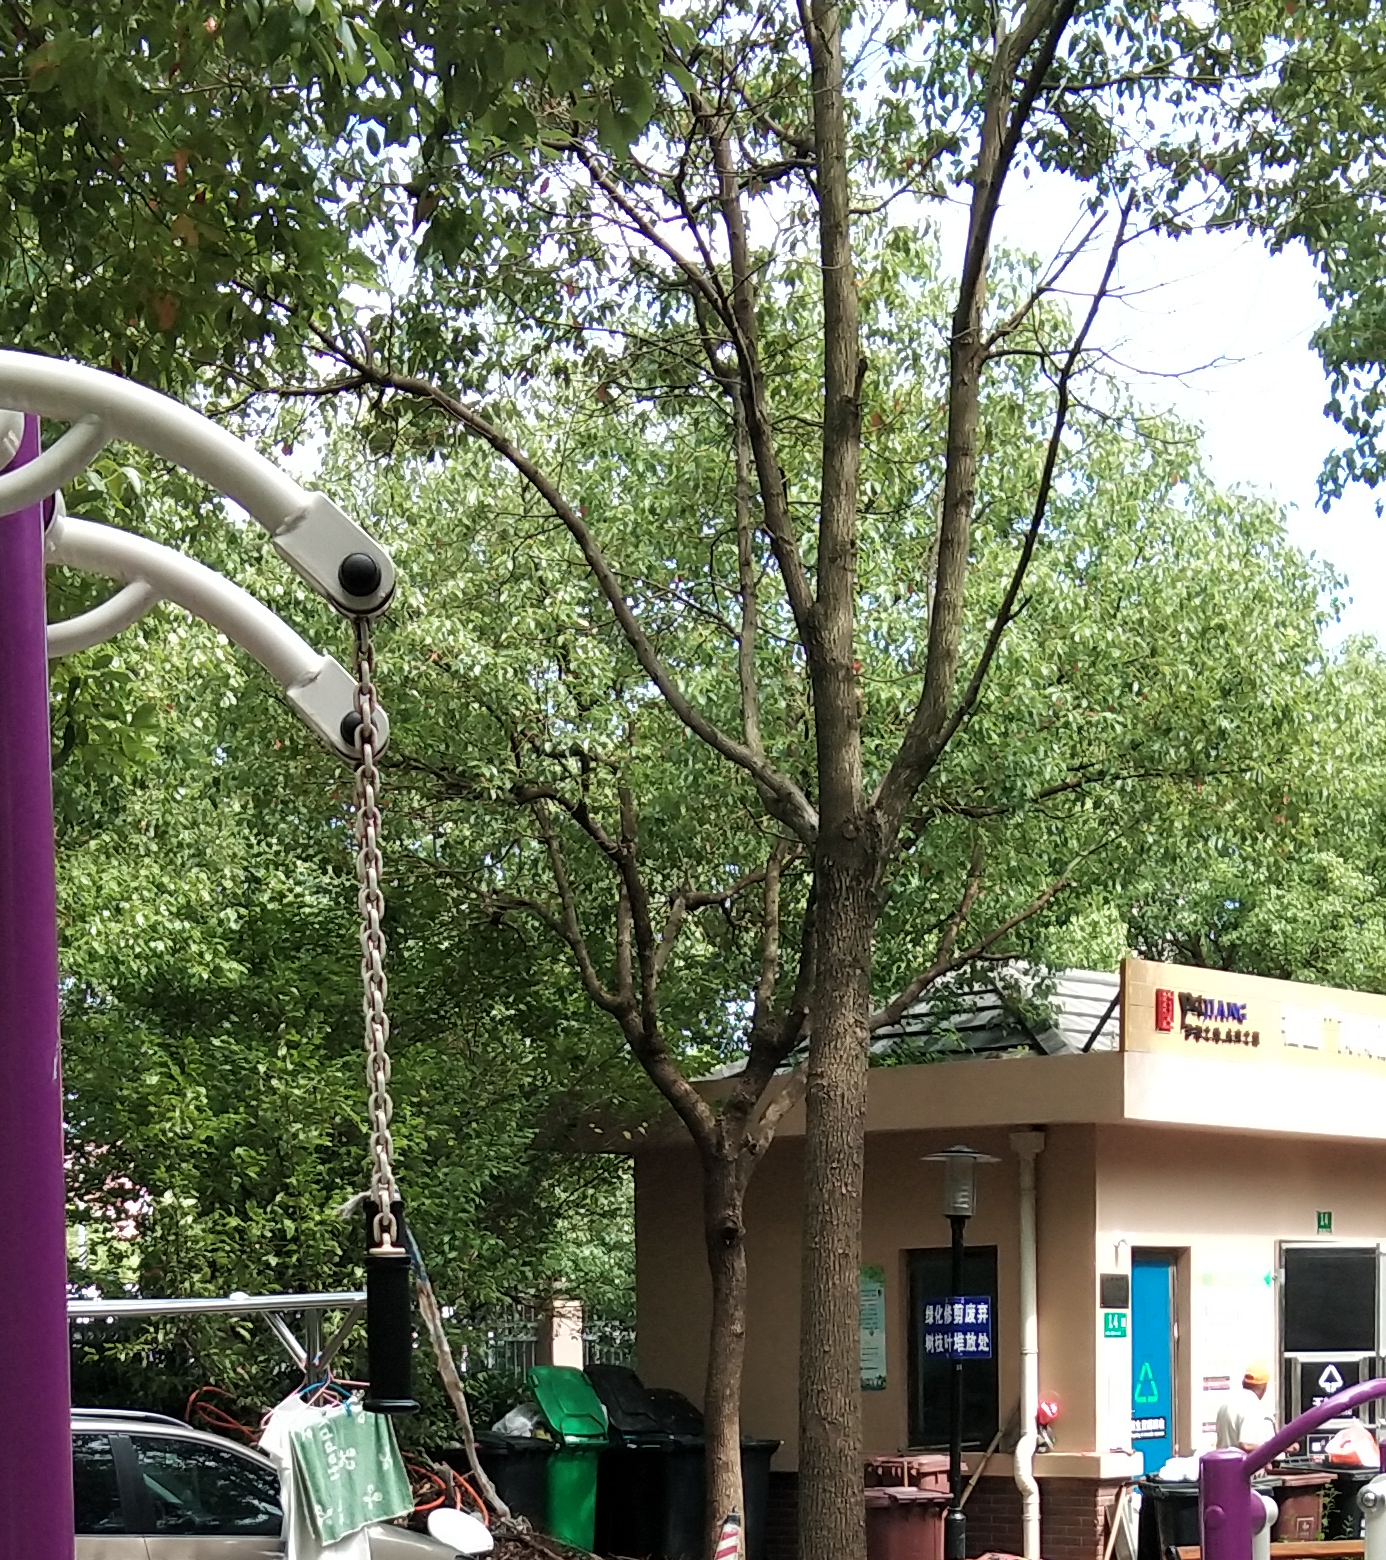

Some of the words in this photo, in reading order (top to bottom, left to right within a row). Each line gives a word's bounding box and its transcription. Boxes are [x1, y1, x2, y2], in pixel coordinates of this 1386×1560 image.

[924, 1303, 989, 1325] 绿化修剪废弃
[924, 1331, 990, 1353] 树枝叶堆放处
